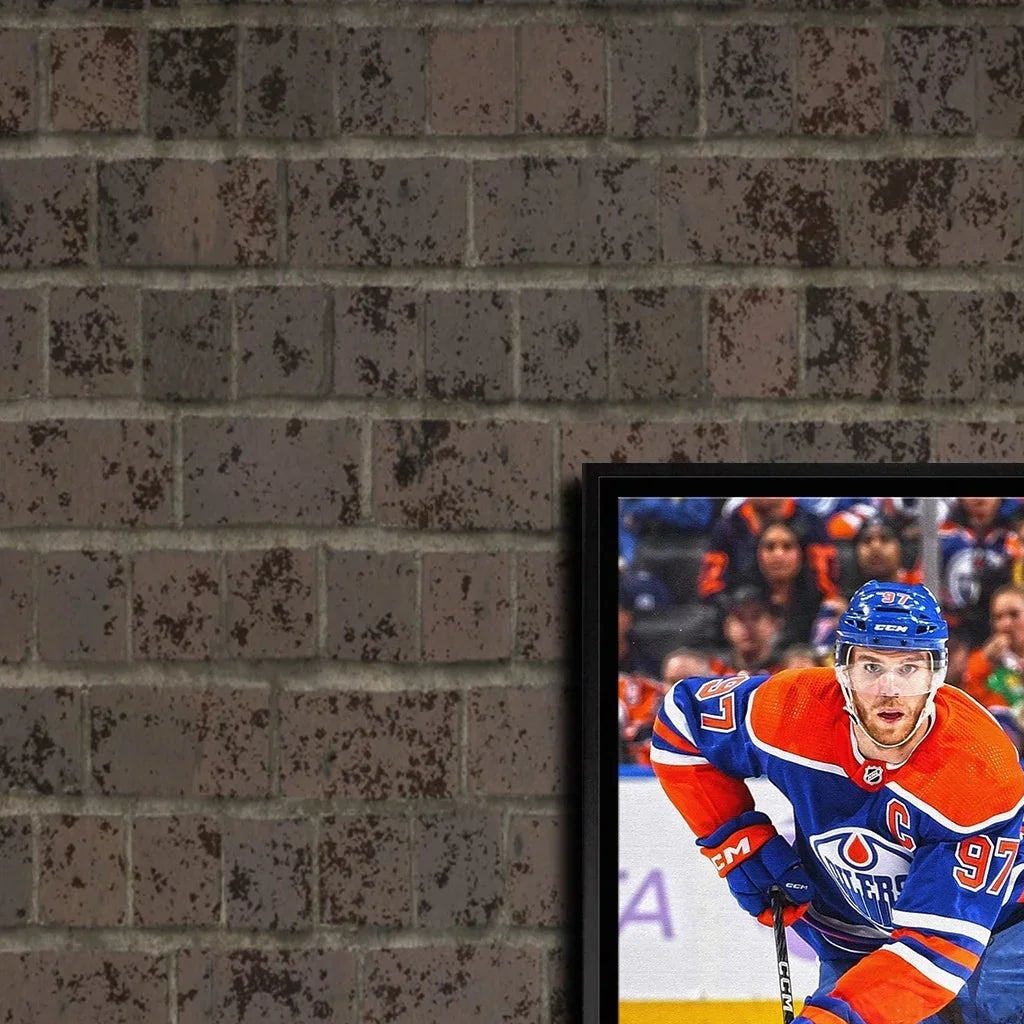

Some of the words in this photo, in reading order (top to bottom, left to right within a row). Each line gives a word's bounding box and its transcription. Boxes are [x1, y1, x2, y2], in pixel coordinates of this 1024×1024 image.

[881, 591, 910, 605] 97
[874, 623, 908, 633] CCM
[695, 675, 750, 734] 97
[886, 798, 917, 853] C
[785, 882, 808, 891] CCM
[953, 834, 1020, 896] 97
[619, 867, 675, 941] A
[778, 960, 793, 1013] CCM
